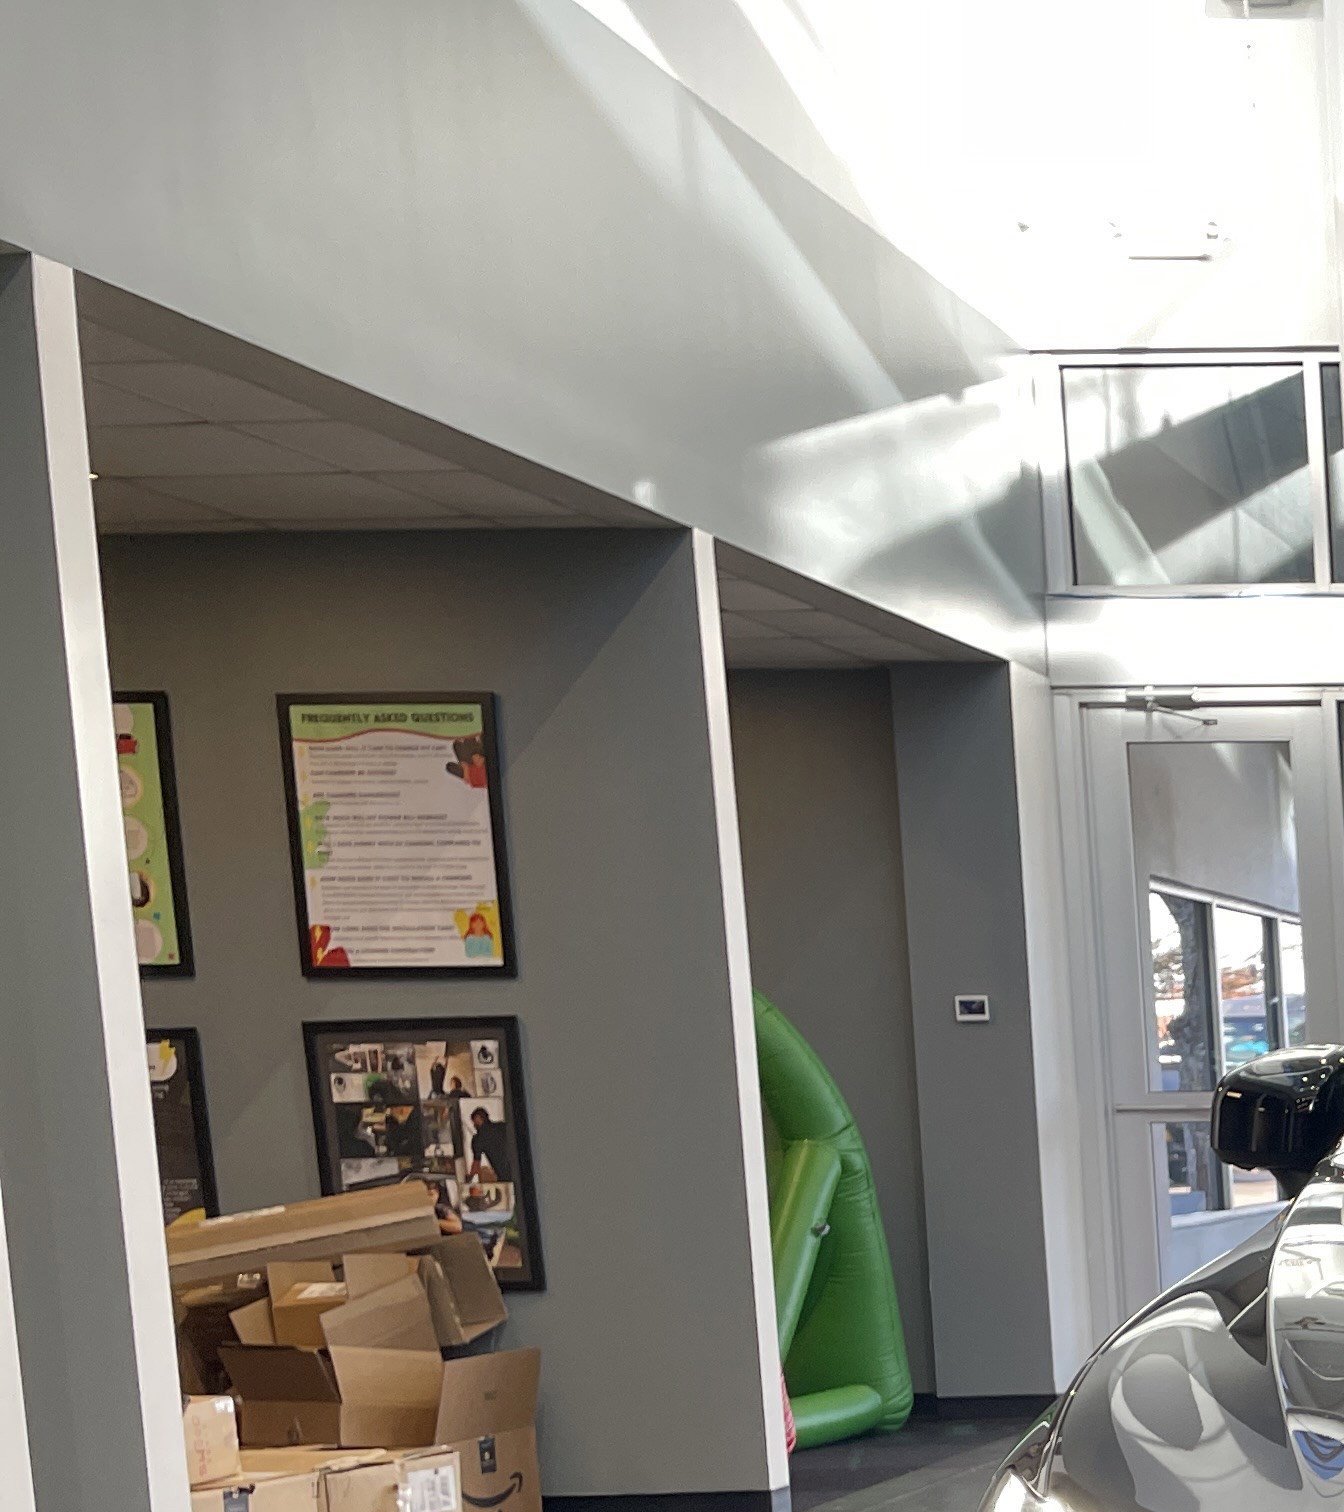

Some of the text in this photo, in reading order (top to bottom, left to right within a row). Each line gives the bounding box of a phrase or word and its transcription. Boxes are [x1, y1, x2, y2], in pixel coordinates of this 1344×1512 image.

[301, 711, 475, 724] FREQUENTLY ASKED QUESTIONS
